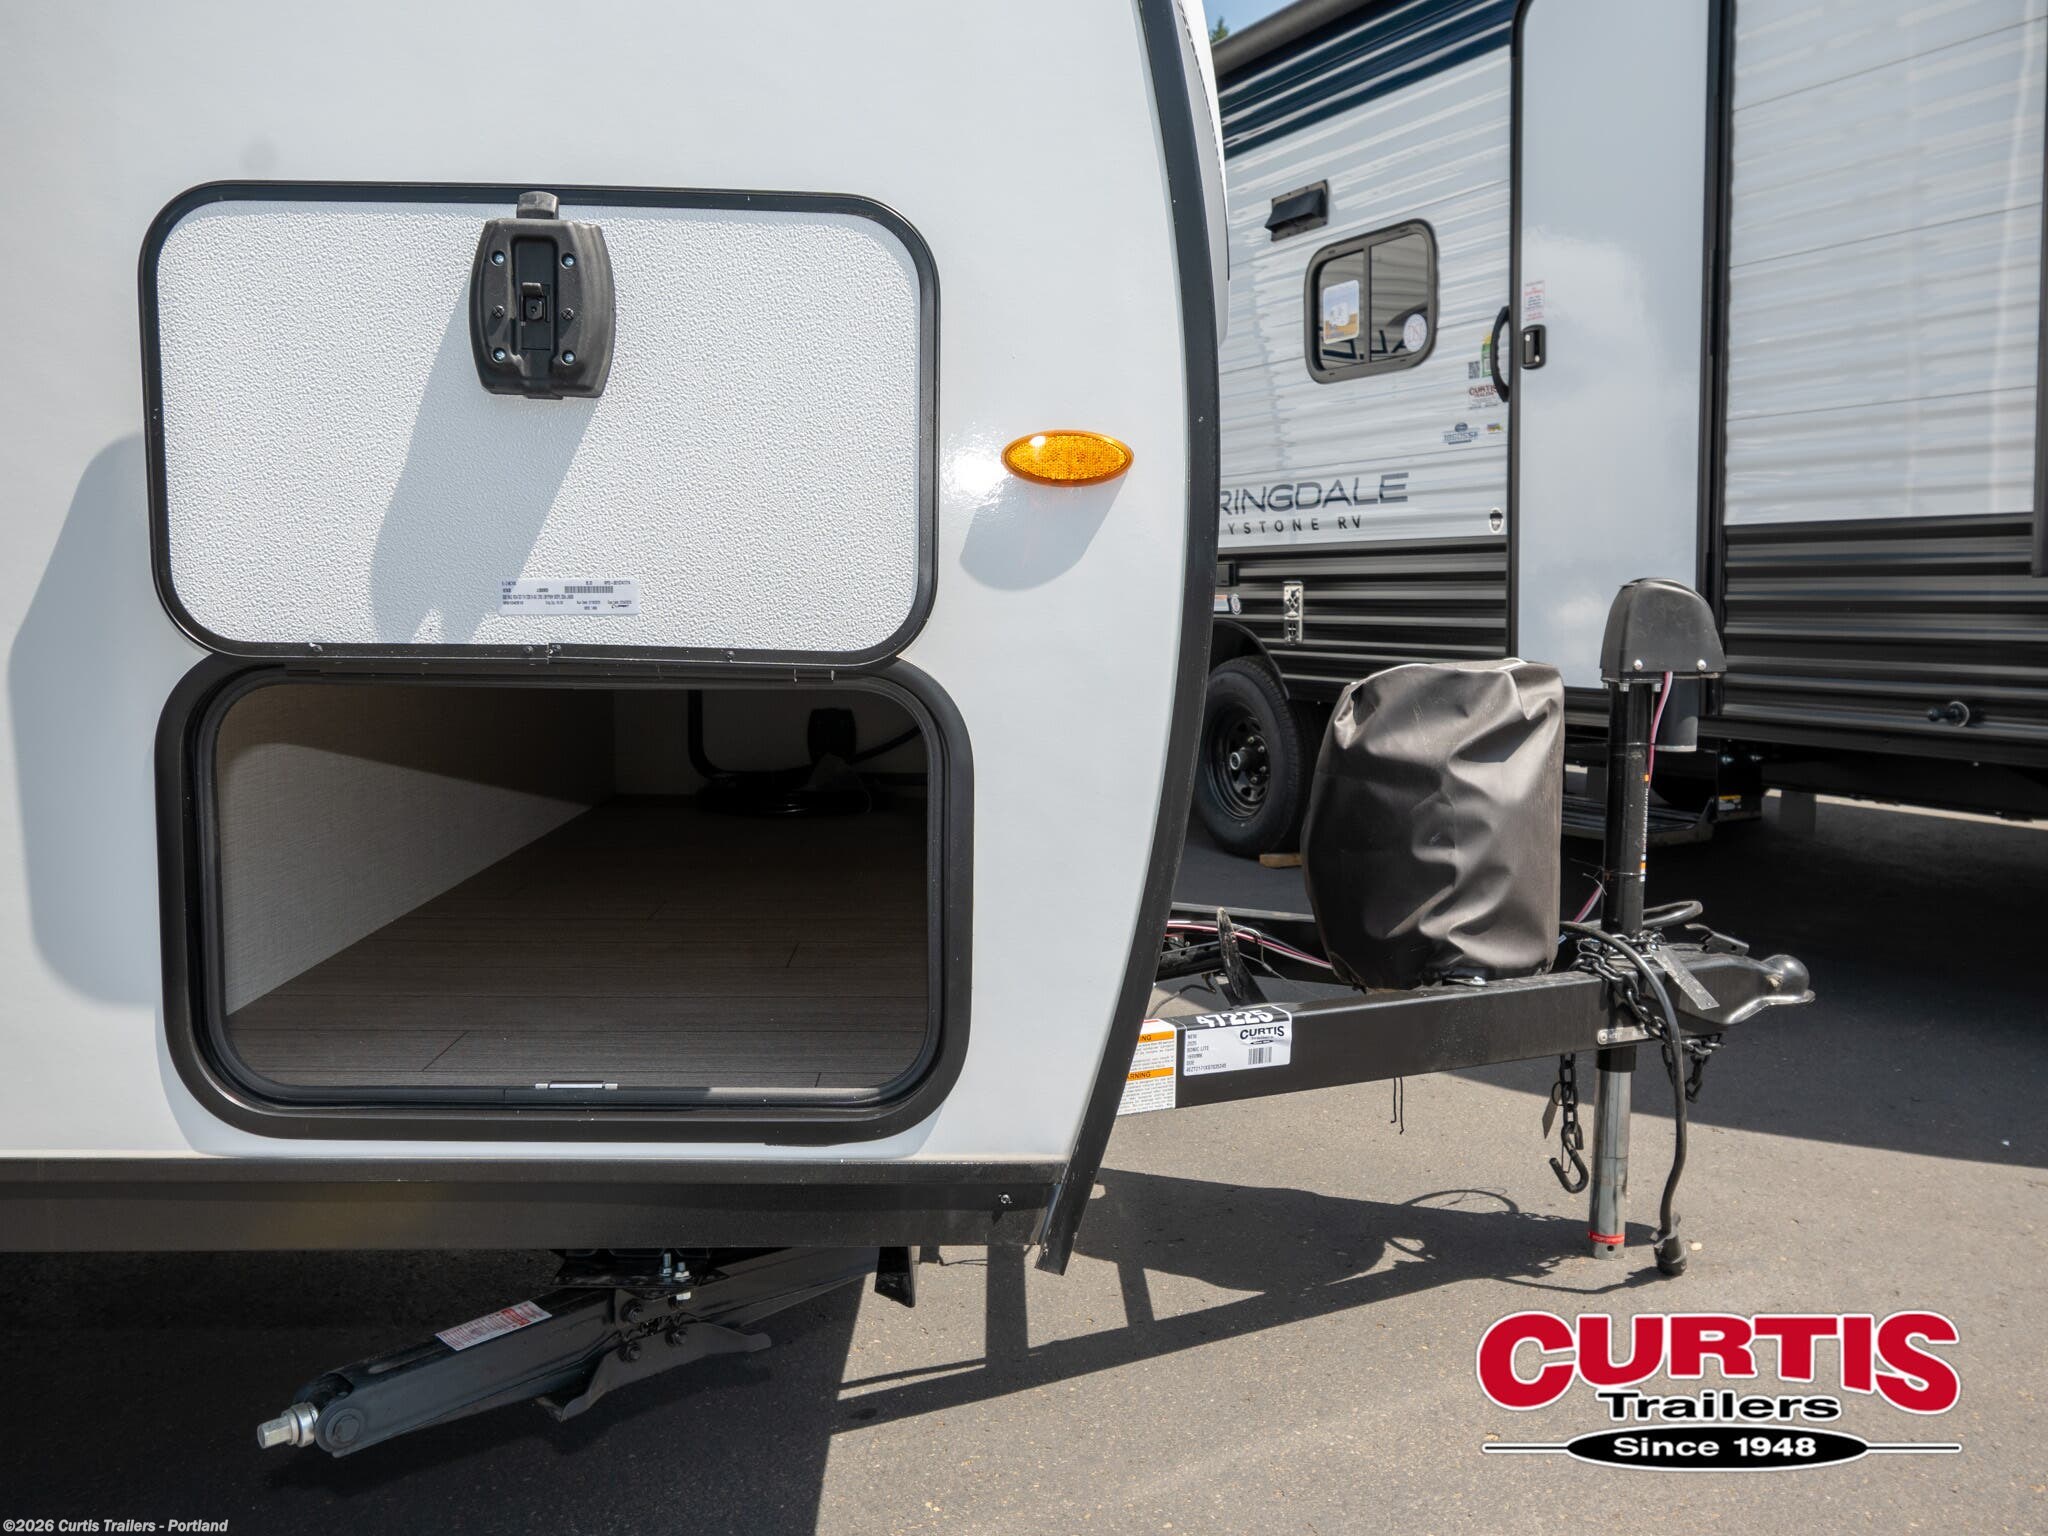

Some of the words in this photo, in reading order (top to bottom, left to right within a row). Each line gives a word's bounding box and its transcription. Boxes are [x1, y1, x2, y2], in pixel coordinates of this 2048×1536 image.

[1337, 515, 1361, 529] RV
[1196, 1009, 1274, 1028] 47225
[1239, 1025, 1285, 1041] CURTIS
